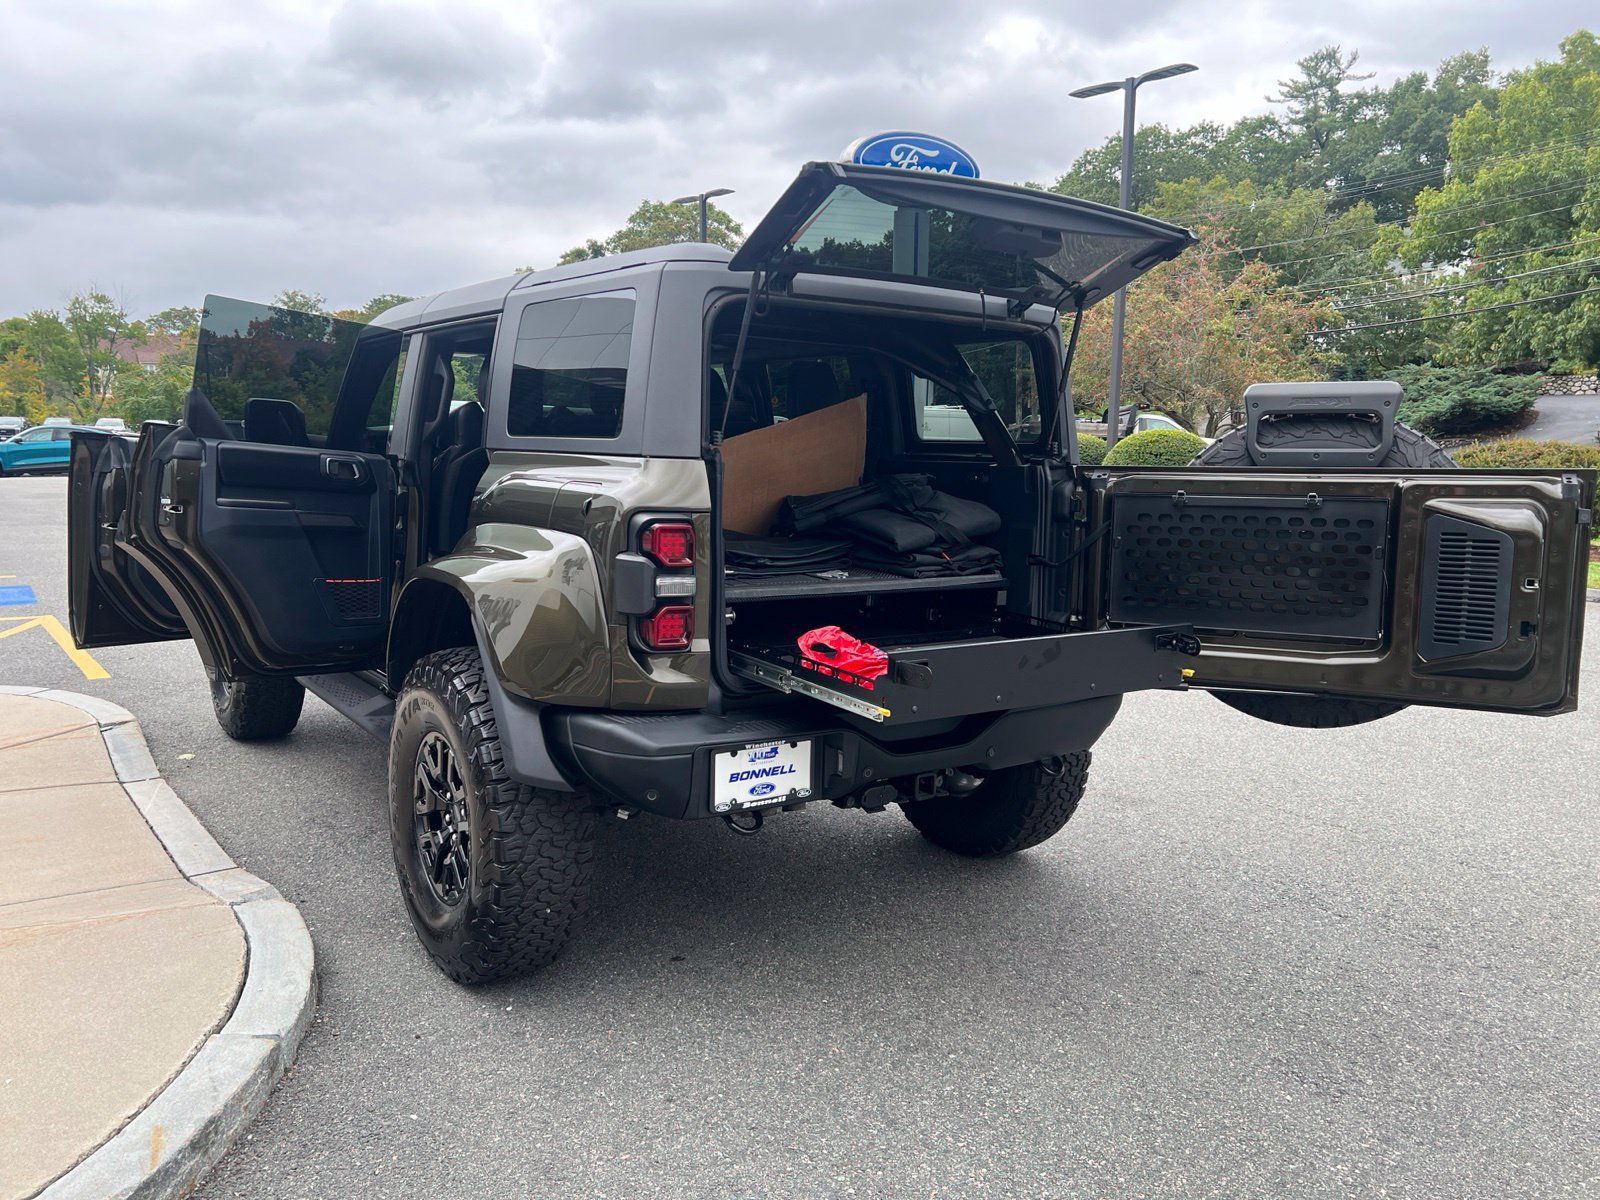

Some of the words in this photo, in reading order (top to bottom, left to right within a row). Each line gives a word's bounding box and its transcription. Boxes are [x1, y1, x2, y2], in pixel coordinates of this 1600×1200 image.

[745, 740, 786, 749] Winchester
[729, 764, 796, 783] BONNELL
[742, 796, 786, 808] Bonnell
